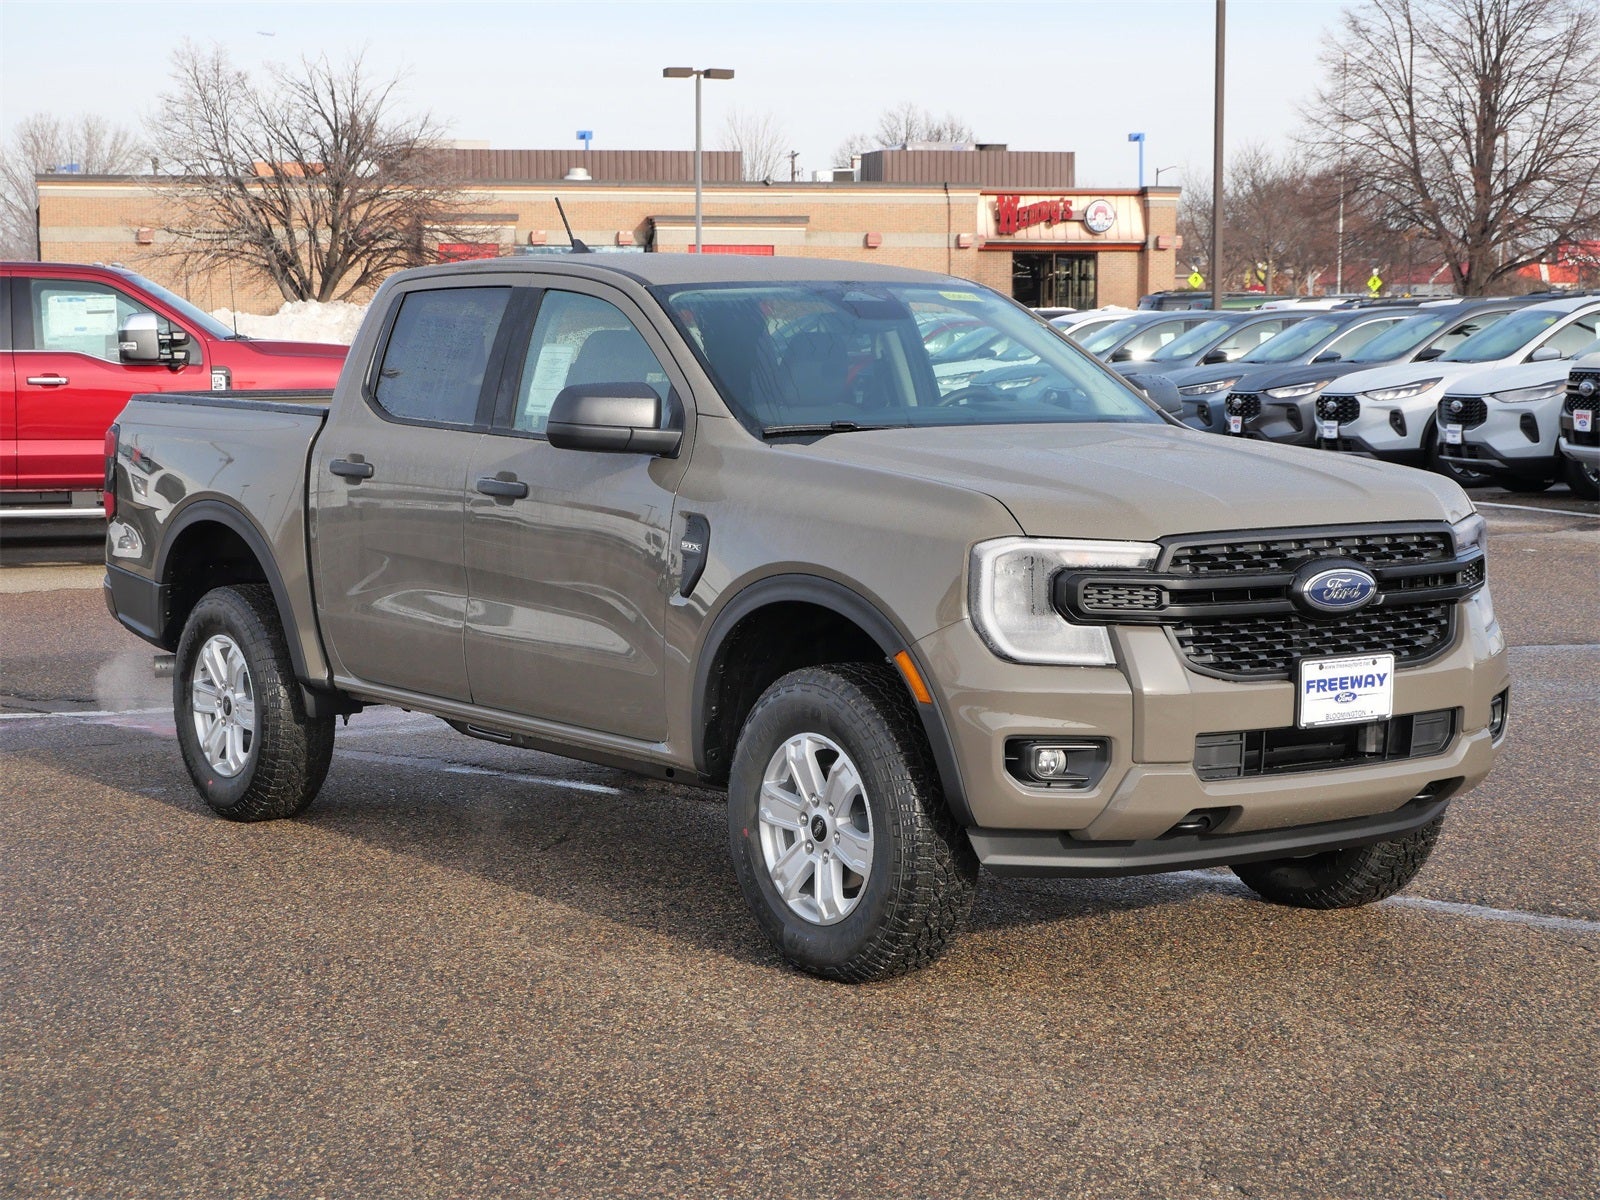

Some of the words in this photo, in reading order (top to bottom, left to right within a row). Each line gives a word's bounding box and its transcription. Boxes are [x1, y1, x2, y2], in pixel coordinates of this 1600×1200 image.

[997, 195, 1073, 234] Wendy's
[681, 542, 702, 552] STX
[1323, 578, 1361, 601] Ford
[1306, 673, 1388, 694] FREEWAY
[1325, 710, 1367, 720] BLOOMINGTON
